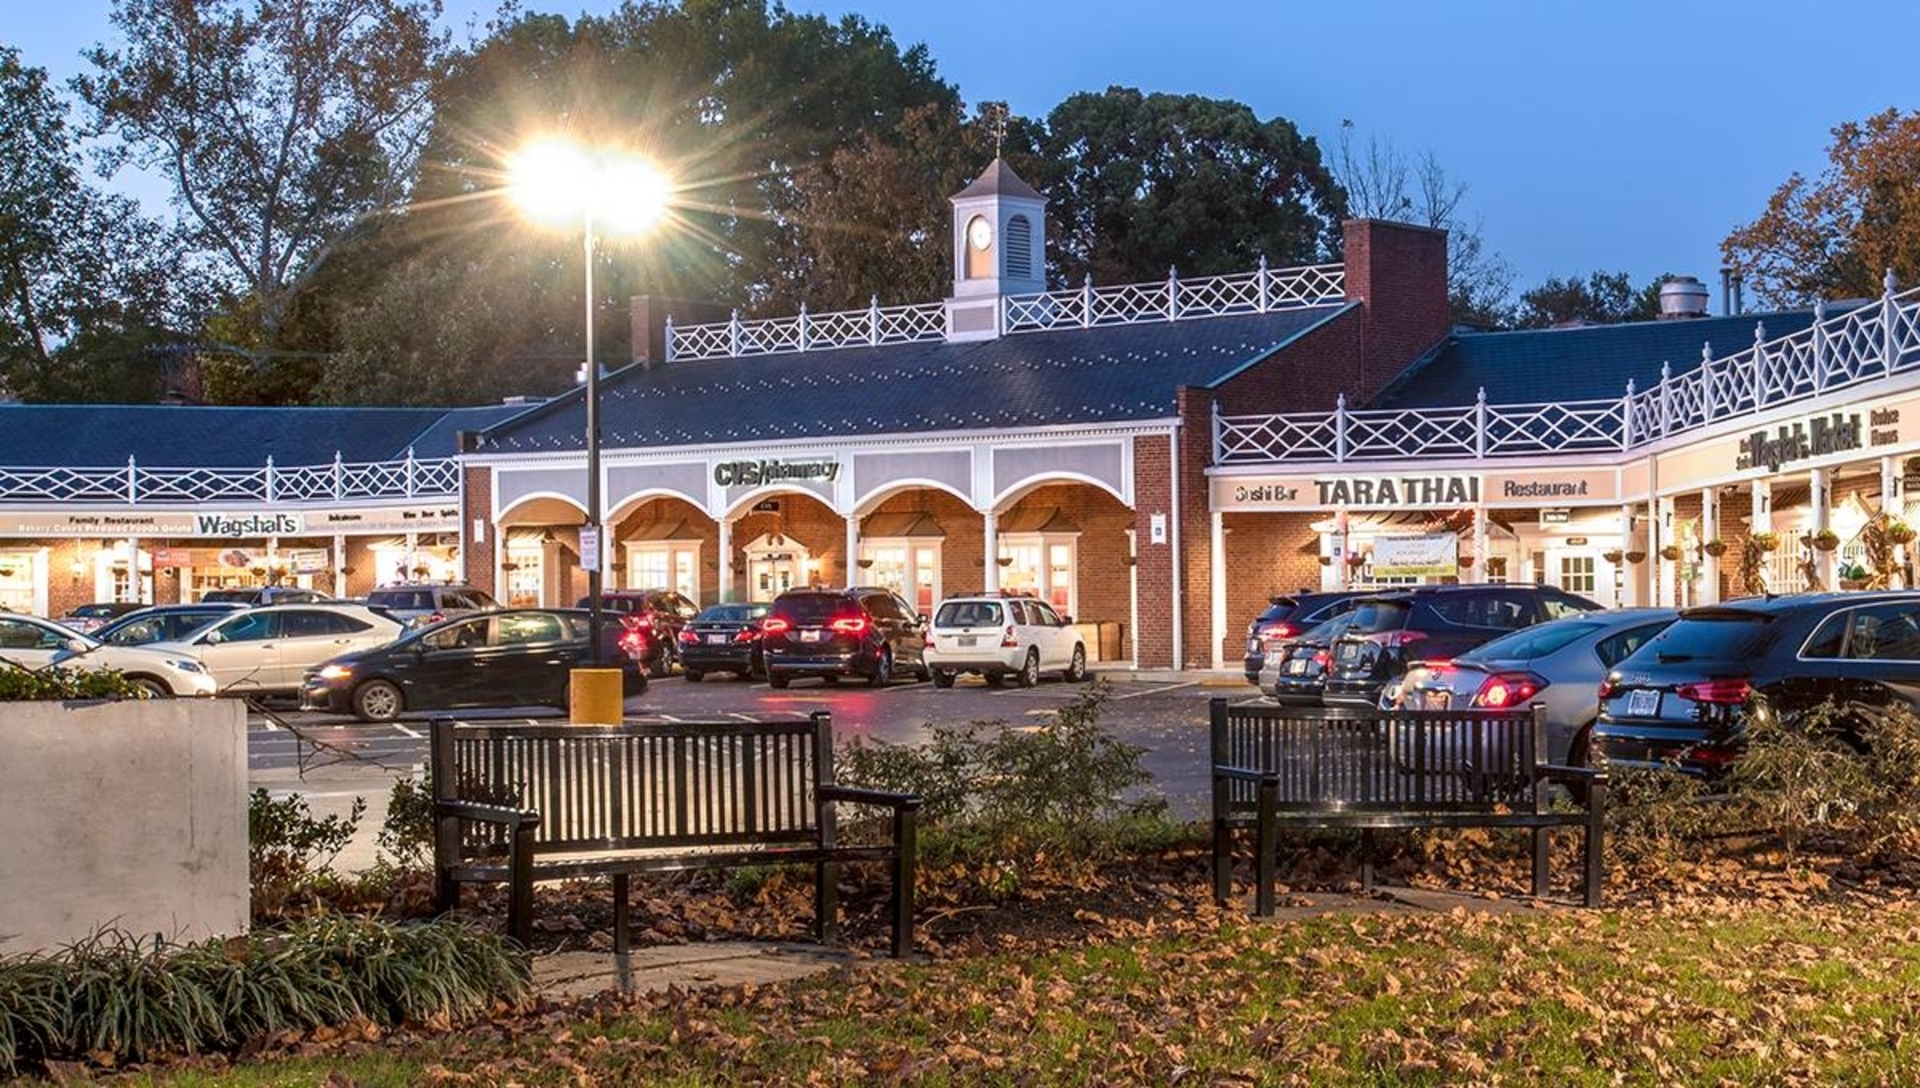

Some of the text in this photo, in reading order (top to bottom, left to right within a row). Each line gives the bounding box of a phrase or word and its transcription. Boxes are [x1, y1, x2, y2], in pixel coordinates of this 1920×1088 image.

[1313, 476, 1479, 505] TARA THAI
[1504, 480, 1588, 497] Restaurant
[69, 516, 155, 525] Family Restaurant
[198, 514, 296, 537] Wagshal's
